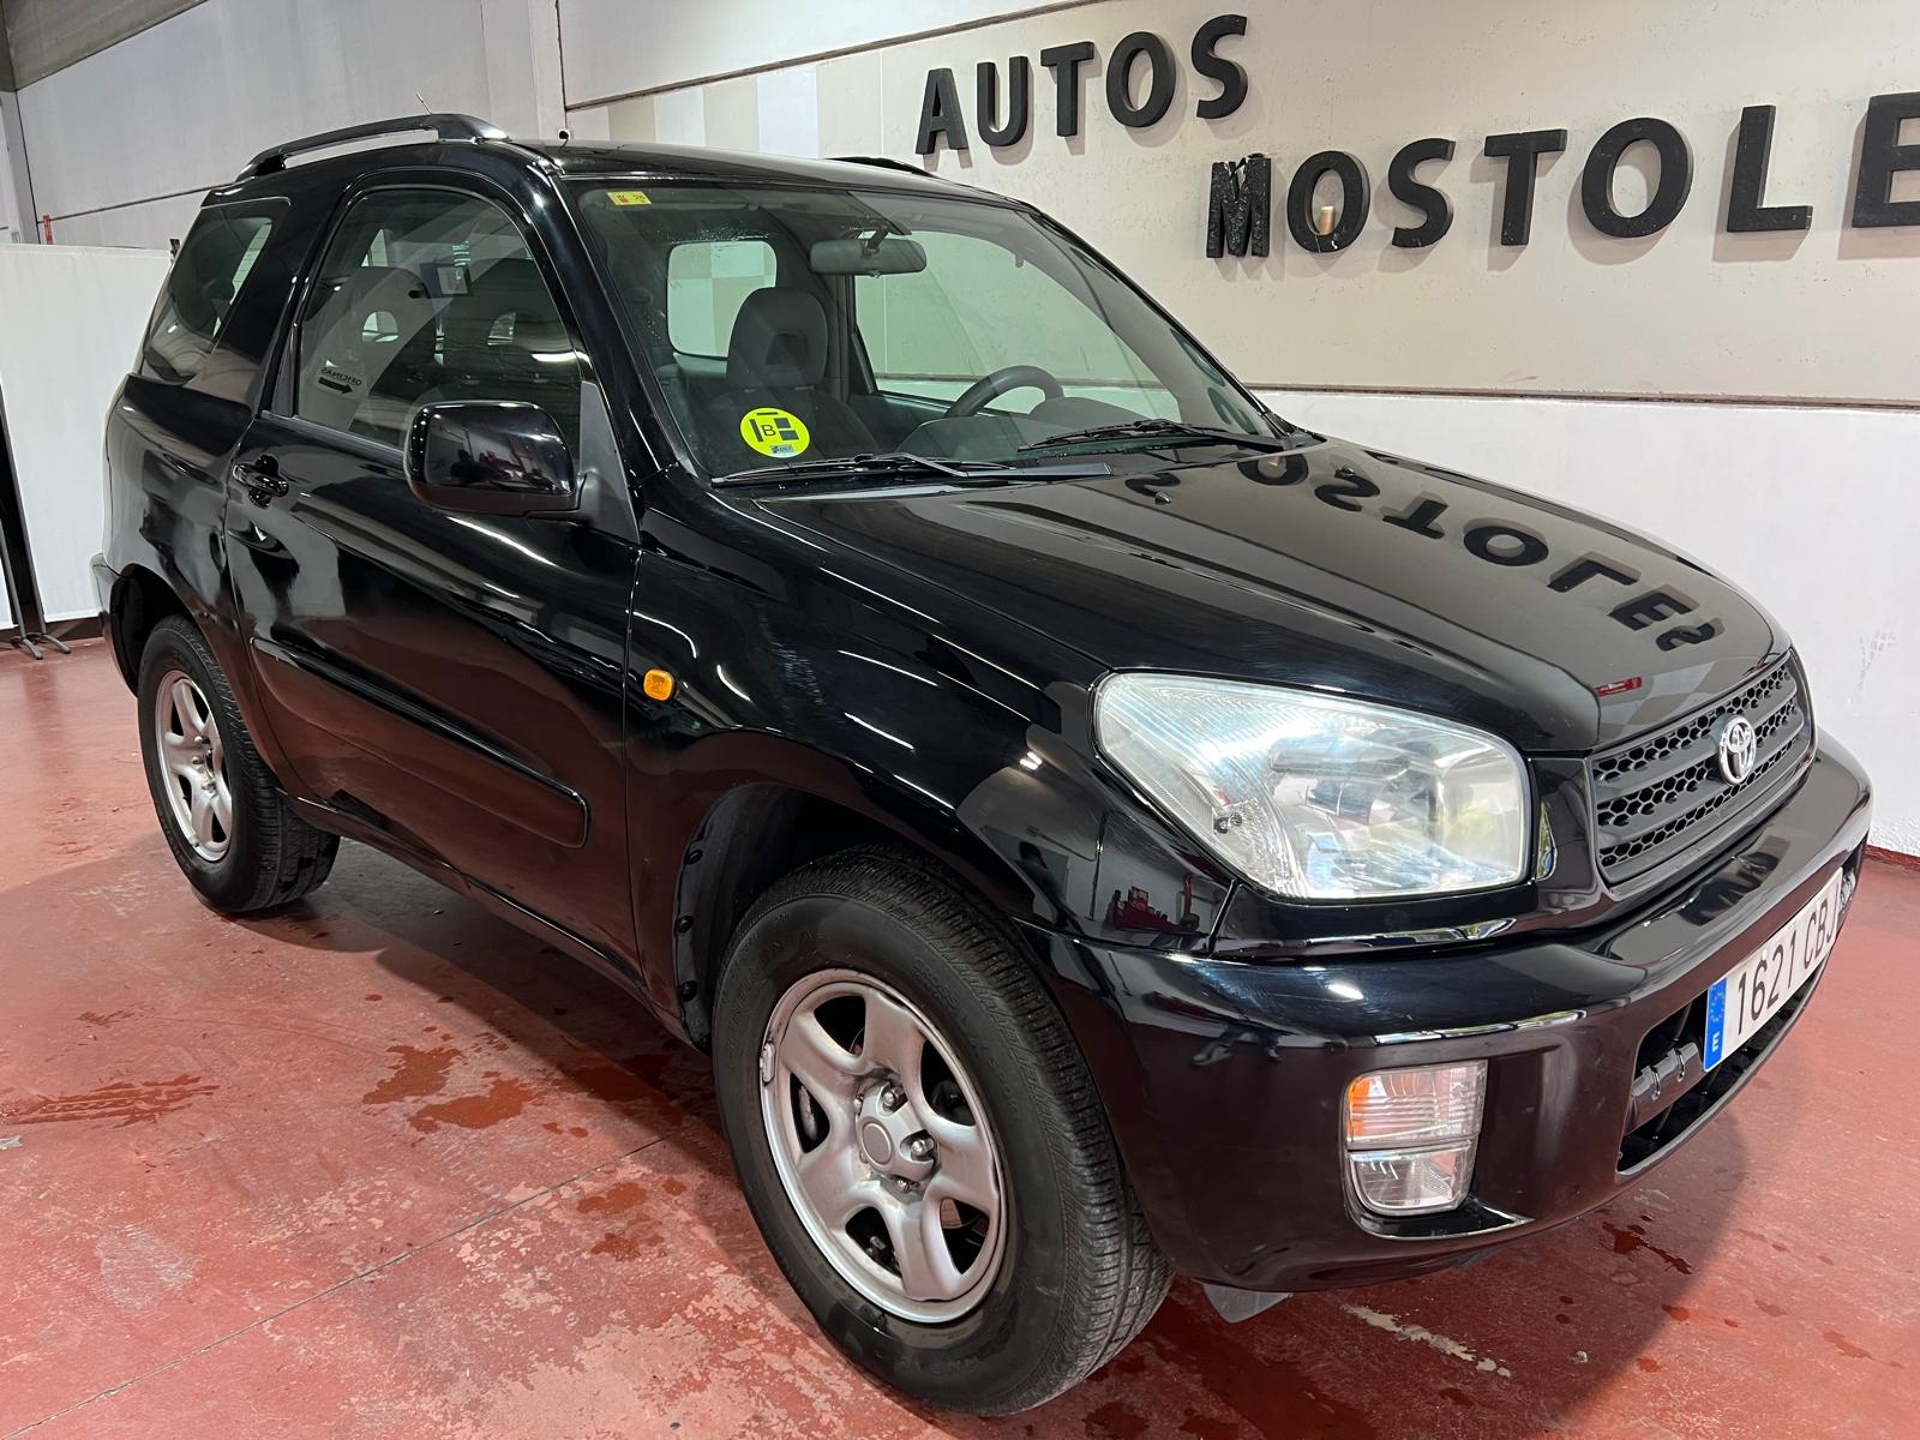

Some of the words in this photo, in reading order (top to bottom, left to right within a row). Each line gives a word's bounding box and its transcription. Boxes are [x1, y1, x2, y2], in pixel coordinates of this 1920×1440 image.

[915, 13, 1249, 155] AUTOS
[1206, 91, 1920, 258] MOSTOLE
[761, 424, 776, 436] B
[1737, 929, 1797, 1035] 1621
[1803, 882, 1840, 970] CBJ
[1711, 1032, 1720, 1053] E
